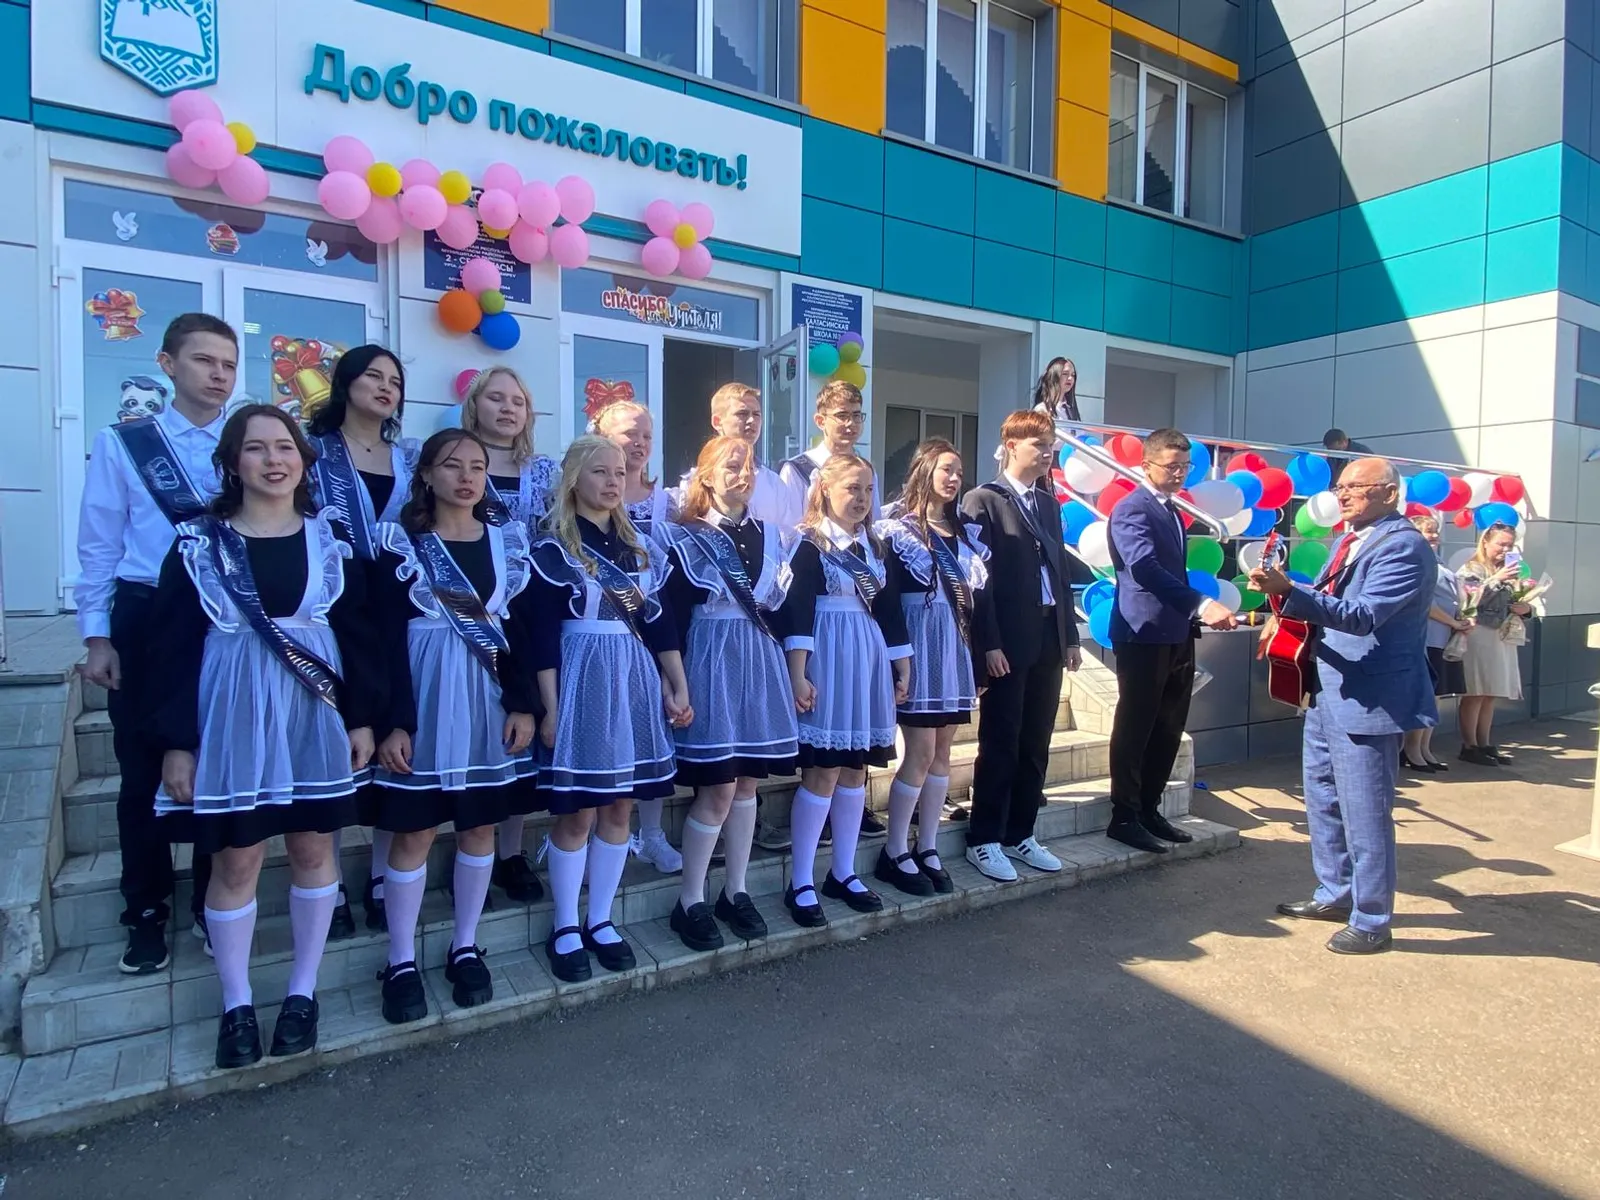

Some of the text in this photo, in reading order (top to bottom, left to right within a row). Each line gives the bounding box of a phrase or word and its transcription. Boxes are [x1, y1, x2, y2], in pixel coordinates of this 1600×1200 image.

[304, 43, 748, 191] Добро пожаловать!
[445, 254, 452, 263] 2
